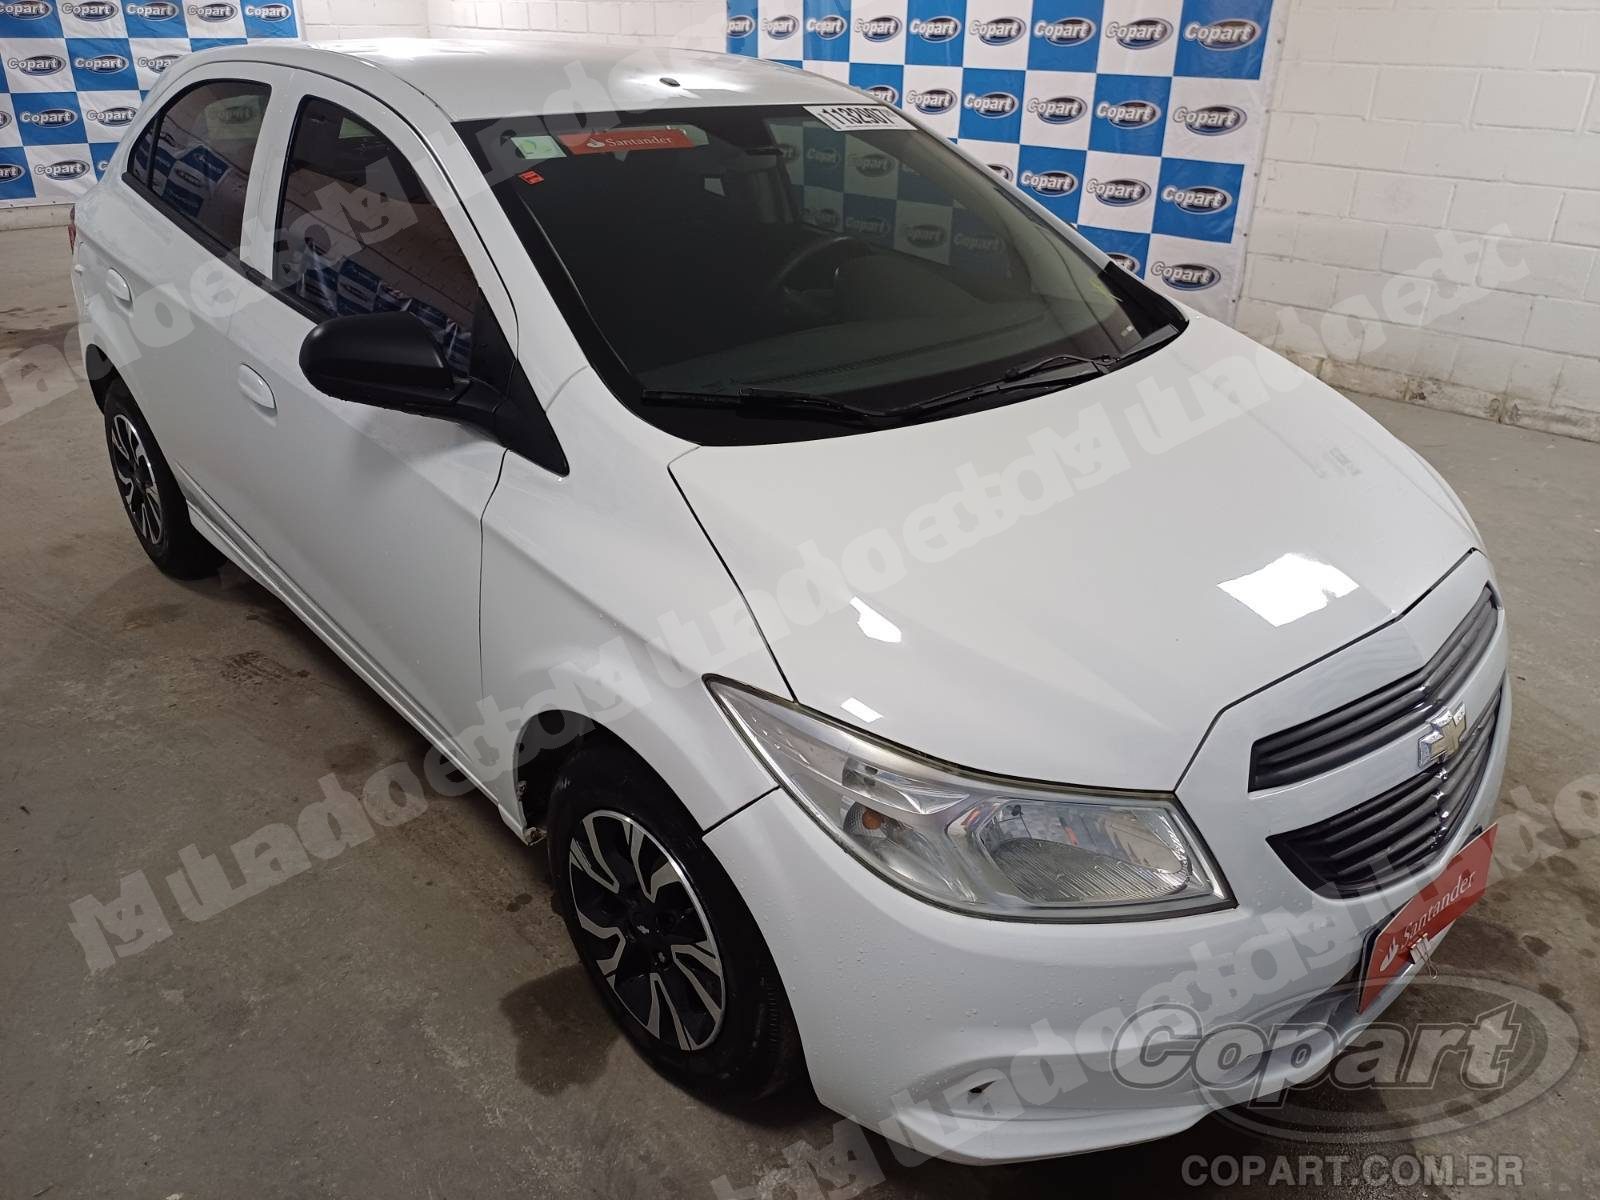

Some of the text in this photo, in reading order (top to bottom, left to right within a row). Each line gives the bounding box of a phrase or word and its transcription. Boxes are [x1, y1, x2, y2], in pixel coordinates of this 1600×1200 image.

[62, 3, 110, 15] Copart
[127, 3, 172, 17] Copart
[188, 5, 232, 18] Copart
[245, 5, 287, 18] Copart
[727, 21, 750, 36] part
[855, 18, 896, 37] Copart
[910, 19, 954, 38] Copart
[969, 20, 1018, 39] Copart
[1034, 21, 1088, 41] Copart
[1105, 22, 1162, 44] Copart
[1183, 23, 1252, 45] Copart
[8, 57, 58, 72] Copart
[75, 57, 122, 71] Copart
[138, 57, 172, 70] Copa
[906, 90, 950, 108] Copart
[964, 94, 1010, 112] Copart
[1027, 97, 1079, 118] Copart
[21, 111, 71, 124] Copart
[87, 109, 135, 122] Copart
[822, 107, 896, 125] 1132907
[1096, 102, 1154, 123] Copart
[1173, 106, 1236, 129] Copart
[606, 135, 673, 147] Santander
[35, 160, 83, 175] Copart
[1020, 171, 1072, 192] Copart
[1086, 178, 1142, 200] Copart
[1161, 186, 1223, 209] Copart
[1151, 260, 1211, 285] Copart
[1403, 871, 1476, 941] Santander
